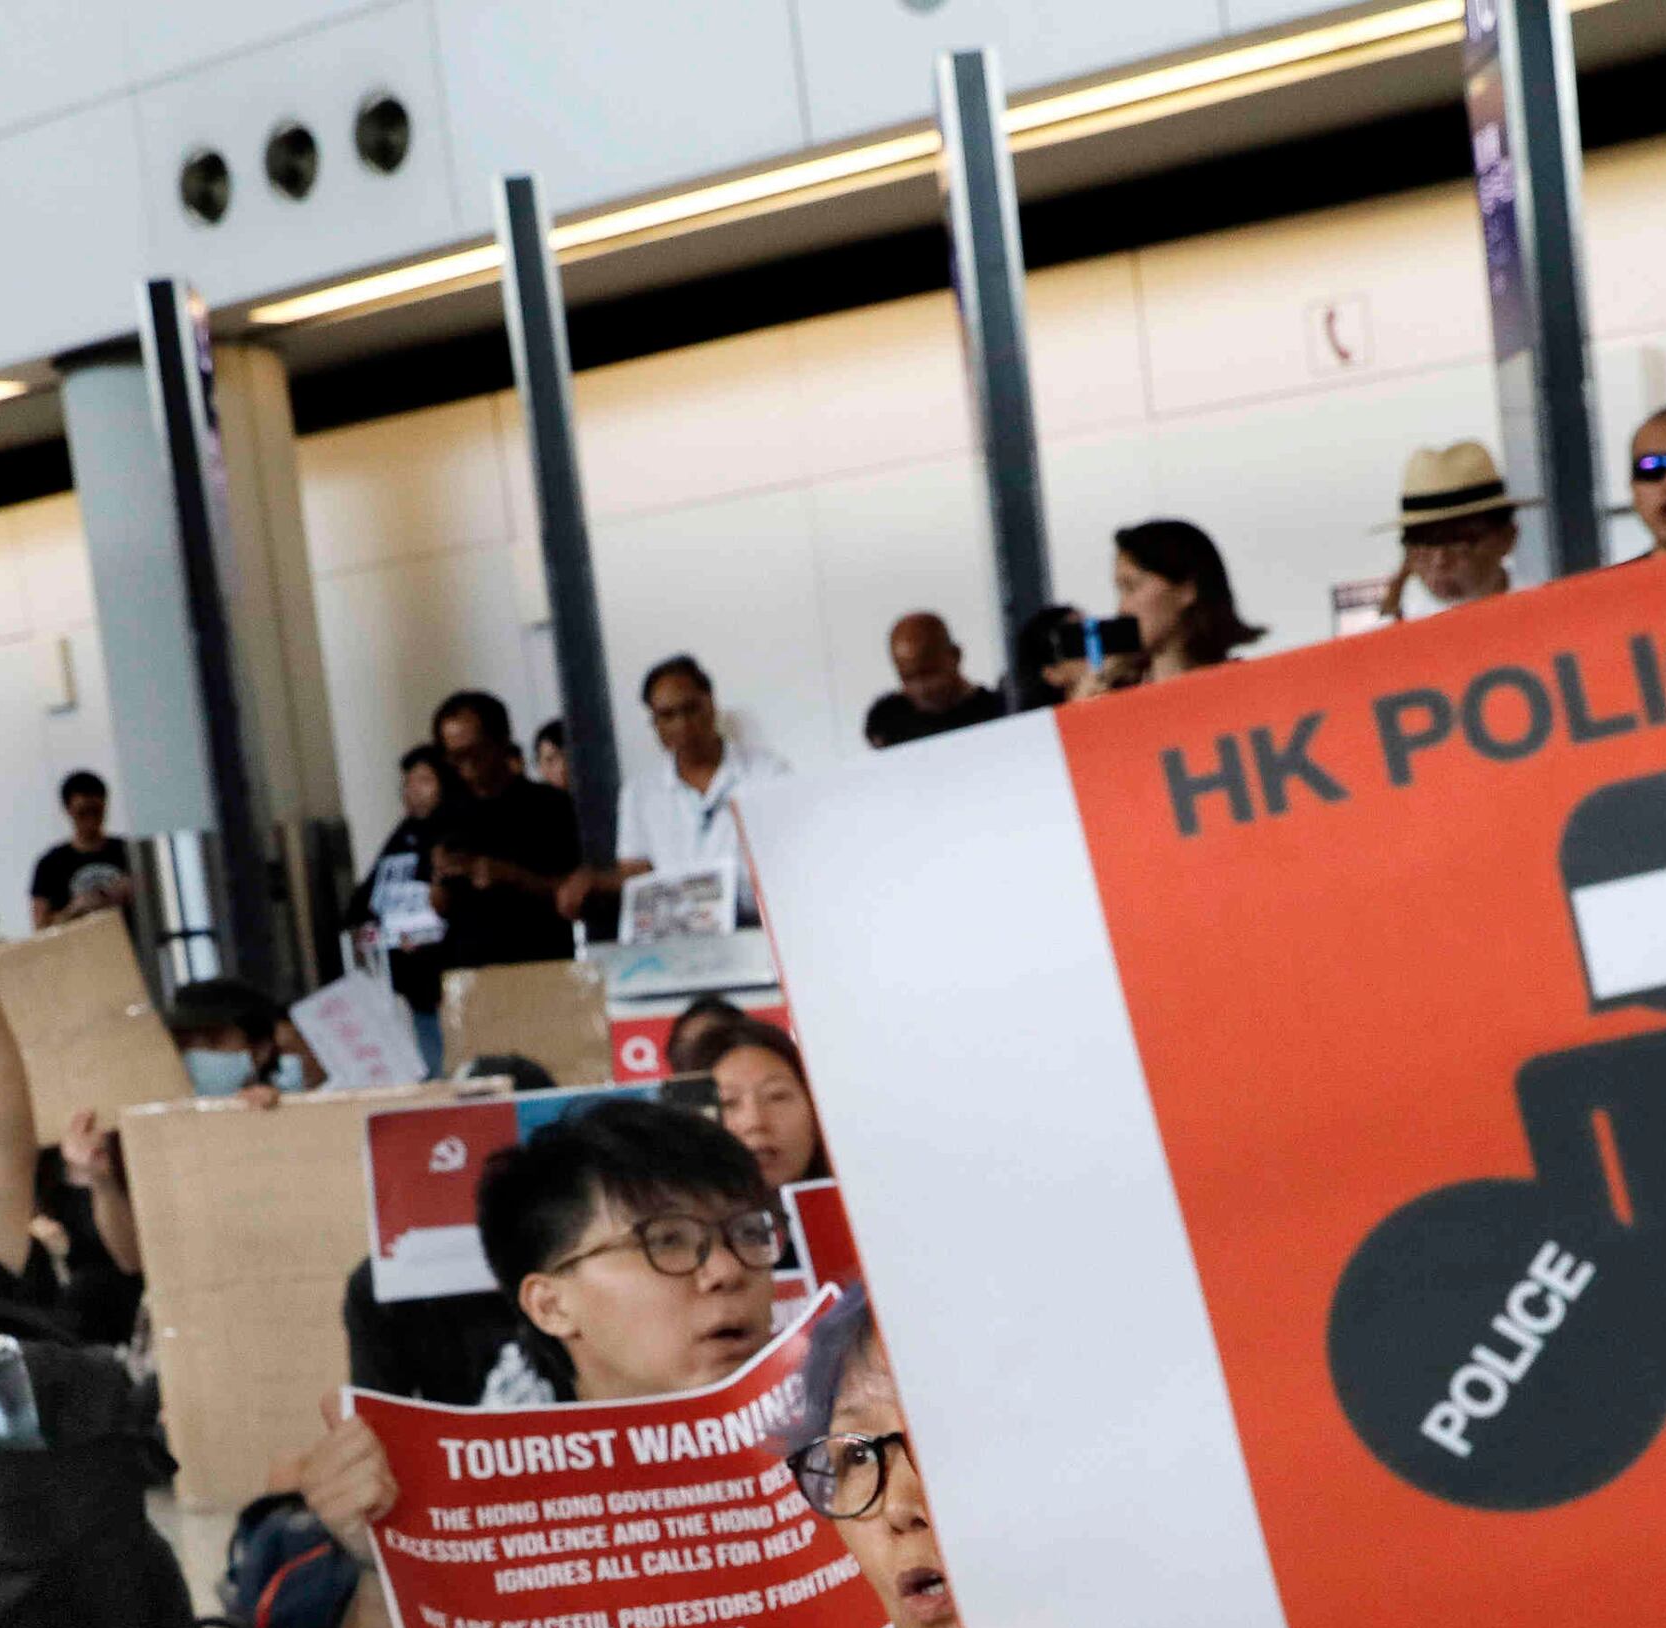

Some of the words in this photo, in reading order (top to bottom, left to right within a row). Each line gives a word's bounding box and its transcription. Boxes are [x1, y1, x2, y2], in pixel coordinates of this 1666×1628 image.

[1160, 711, 1349, 837] HK
[621, 1036, 660, 1073] Q
[1420, 1239, 1597, 1459] POLICE
[437, 1428, 618, 1481] TOURIST
[429, 1506, 472, 1532] THE
[475, 1500, 539, 1529] HONG
[541, 1493, 605, 1521] KONG
[606, 1477, 756, 1515] GOVERNMENT
[500, 1524, 611, 1560] VIOLENCE
[612, 1518, 661, 1547] AND
[663, 1512, 710, 1540] THE
[711, 1505, 775, 1535] HONG
[494, 1558, 593, 1595] IGNORES
[595, 1554, 640, 1582] ALL
[641, 1545, 714, 1577] CALLS
[715, 1539, 763, 1568] FOR
[763, 1519, 818, 1561] HELP
[765, 1552, 862, 1612] FIGHTING
